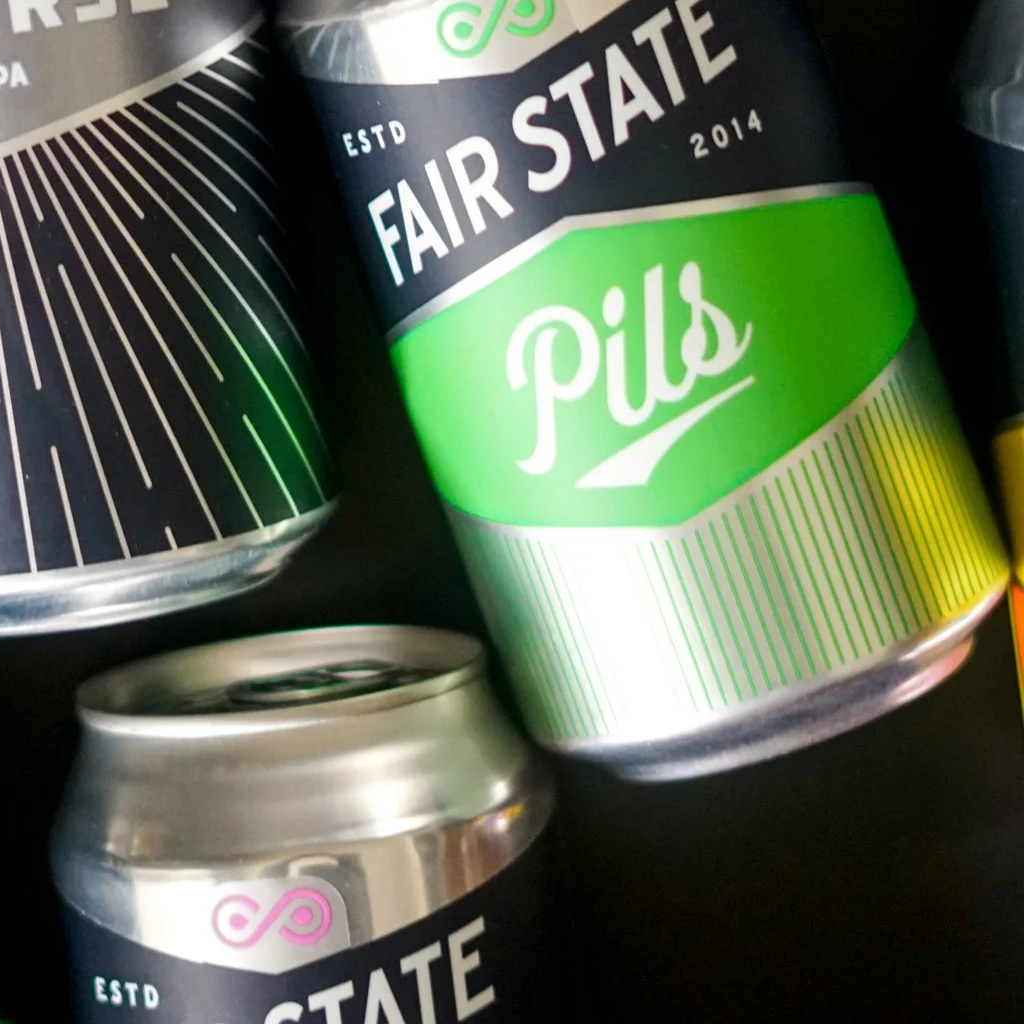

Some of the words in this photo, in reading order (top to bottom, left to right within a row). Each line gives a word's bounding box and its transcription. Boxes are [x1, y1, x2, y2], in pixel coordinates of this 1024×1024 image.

[343, 120, 407, 157] ESTD
[689, 109, 764, 160] 2014
[367, 135, 514, 288] FAIR
[505, 260, 753, 475] Pils
[93, 976, 161, 1010] ESTD
[264, 915, 496, 1024] TATE
